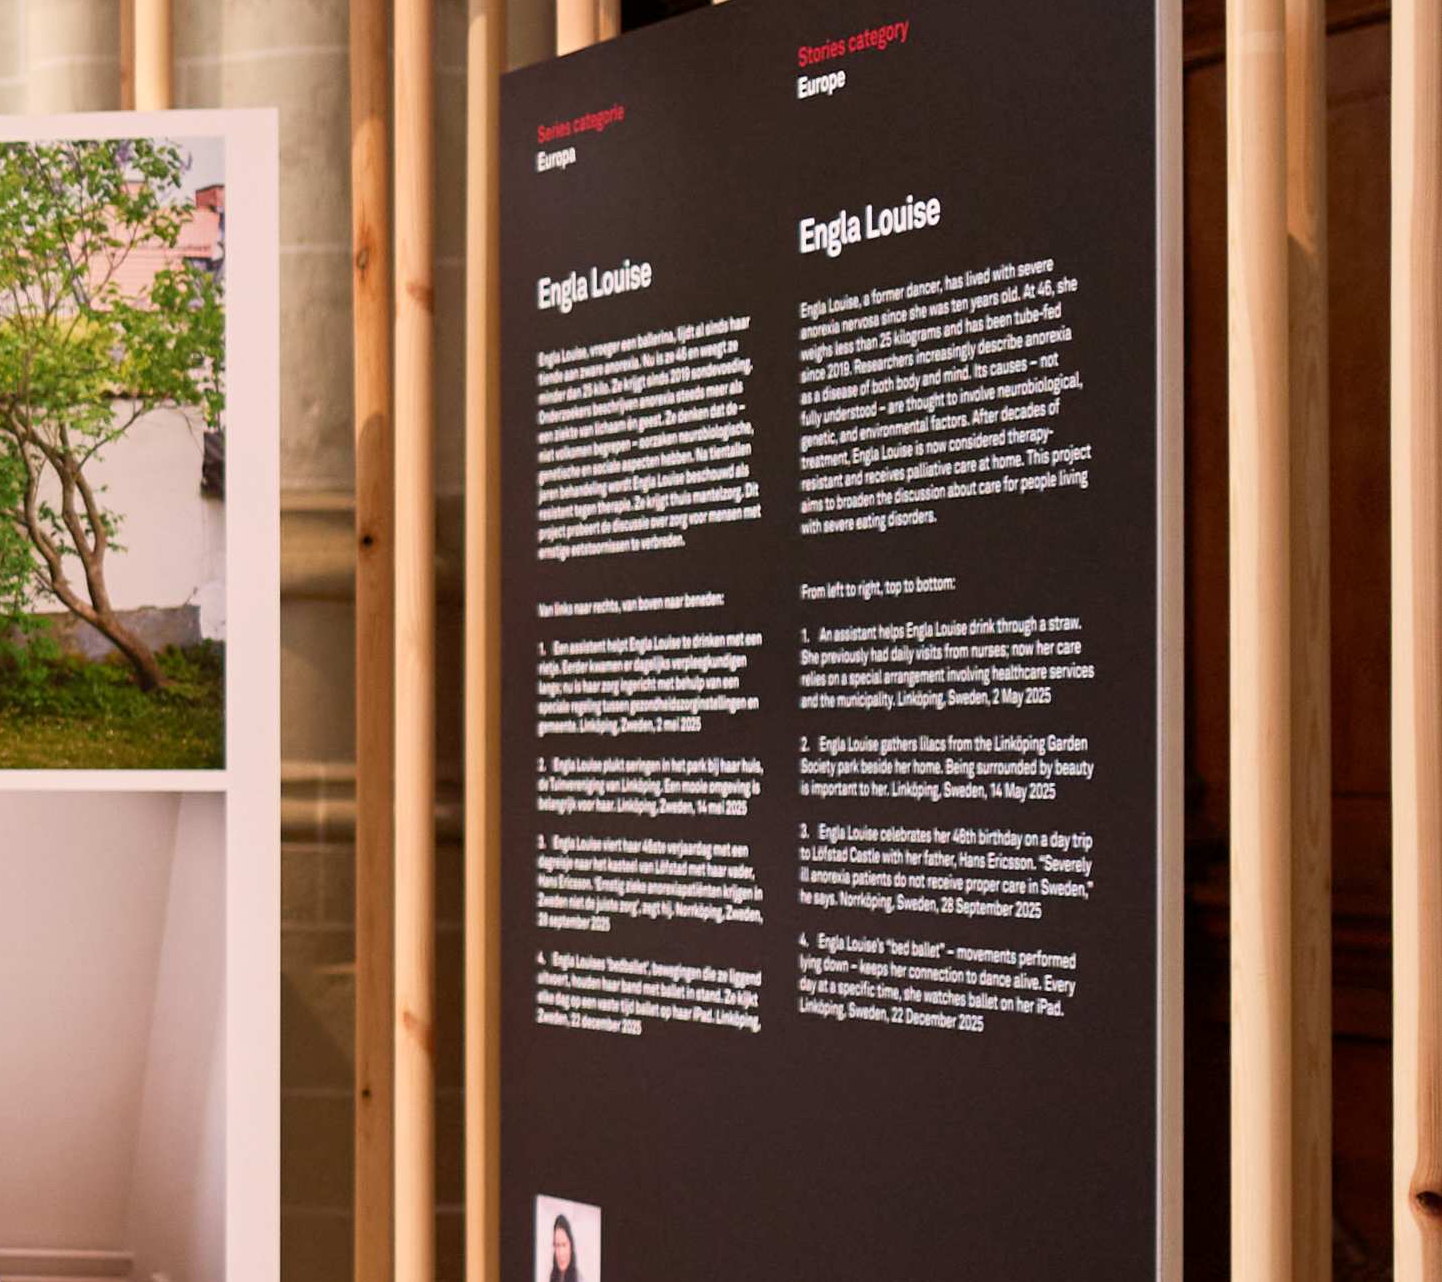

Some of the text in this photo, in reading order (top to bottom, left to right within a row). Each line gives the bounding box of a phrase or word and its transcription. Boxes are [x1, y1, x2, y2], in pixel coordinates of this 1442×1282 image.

[797, 21, 908, 67] Stories category
[797, 70, 845, 98] Europe
[537, 104, 624, 143] Series categorie
[536, 146, 576, 171] Europa
[799, 194, 940, 257] Engla Louise
[537, 259, 651, 313] Engla Louise
[800, 258, 1053, 320] Engla Louise, a former dancer, has lived with severe
[800, 276, 1077, 339] anorexia nervosa since she was ten years old. At 46, she
[800, 301, 1061, 363] weighs less than 25 kilograms and has been tube-fed
[800, 327, 1071, 383] since 2019. Researchers increasingly describe anorexia
[800, 397, 1060, 452] genetic, and environmental factors. After decades of
[800, 427, 1053, 469] treatment, Engla Louise is now considered therapy-
[800, 445, 1091, 491] resistant and receives palliative care at home. This project
[800, 468, 1088, 513] aims to broaden the discussion about care for people living
[800, 508, 937, 534] with severe eating disorders.
[800, 577, 955, 600] From left to right, top to bottom:
[819, 626, 832, 641] An
[833, 626, 876, 641] assistant
[877, 623, 904, 641] helps
[905, 621, 933, 642] Engla
[935, 620, 967, 636] Louise
[968, 618, 995, 635] drink
[995, 616, 1037, 636] through
[1039, 618, 1046, 631] a
[800, 648, 819, 665] She
[820, 648, 869, 667] previously
[870, 646, 888, 662] had
[890, 644, 914, 664] daily
[915, 643, 942, 660] visits
[943, 642, 968, 659] from
[1011, 643, 1033, 656] now
[1035, 639, 1054, 655] her
[1056, 641, 1081, 654] care
[800, 692, 818, 708] and
[819, 692, 835, 708] the
[992, 687, 999, 704] 2
[1000, 687, 1023, 707] May
[1025, 686, 1051, 703] 2025
[800, 757, 836, 776] Society
[837, 758, 859, 776] park
[860, 758, 893, 774] beside
[893, 758, 911, 774] her
[944, 757, 975, 779] Being
[976, 759, 1037, 775] surrounded
[1038, 759, 1053, 779] by
[1054, 760, 1094, 779] beauty
[799, 888, 812, 904] he
[940, 896, 954, 913] 28
[955, 897, 1013, 916] September
[1015, 901, 1041, 918] 2025
[891, 1006, 903, 1023] 22
[904, 1007, 956, 1028] December
[958, 1013, 983, 1031] 2025
